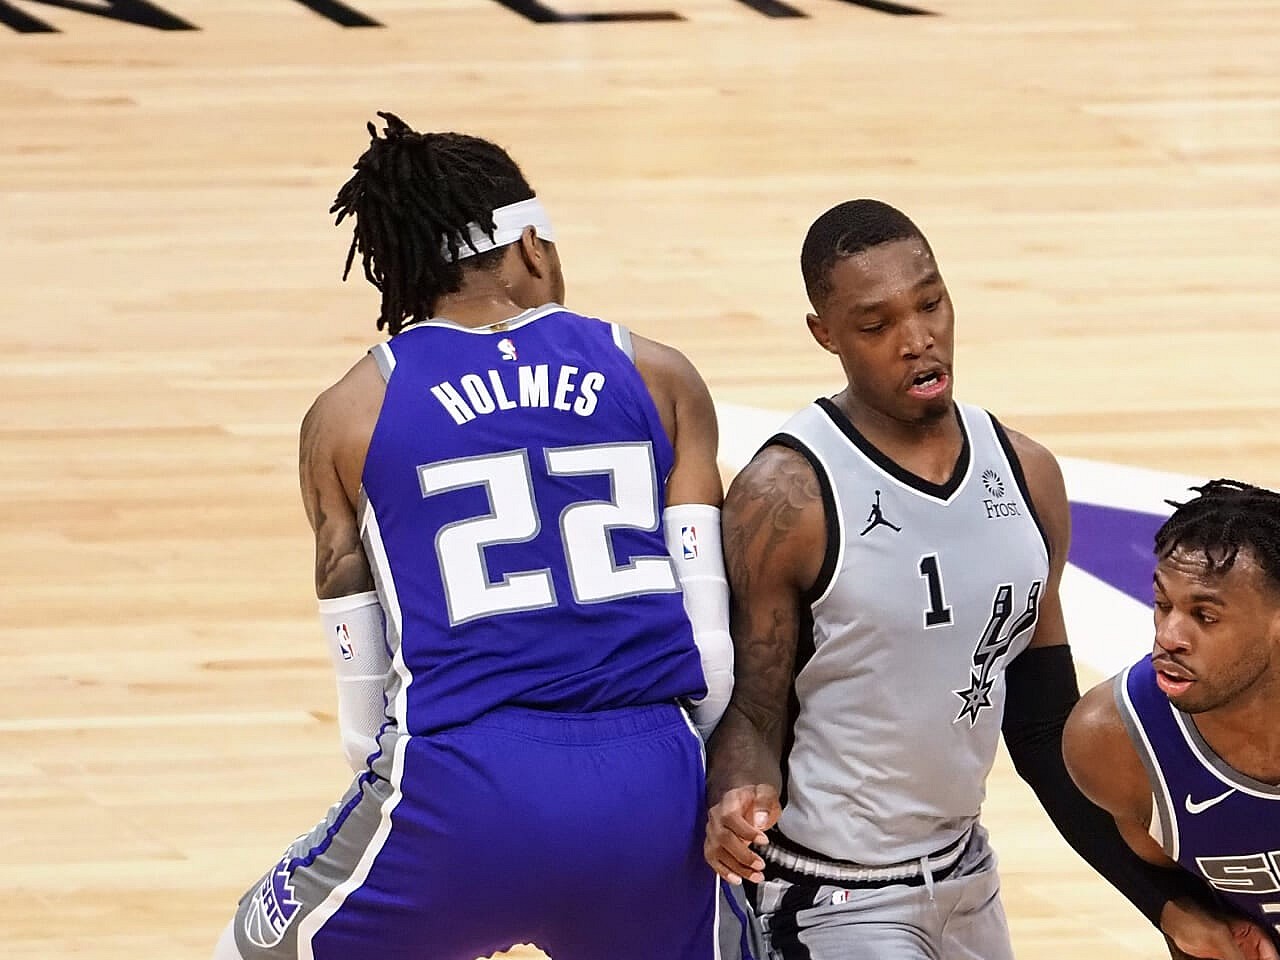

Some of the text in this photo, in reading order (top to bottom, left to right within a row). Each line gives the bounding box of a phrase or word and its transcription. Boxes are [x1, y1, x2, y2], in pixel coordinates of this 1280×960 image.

[430, 364, 606, 425] HOLMES
[416, 440, 683, 627] 22
[983, 499, 1021, 518] Frost
[917, 552, 954, 629] 1
